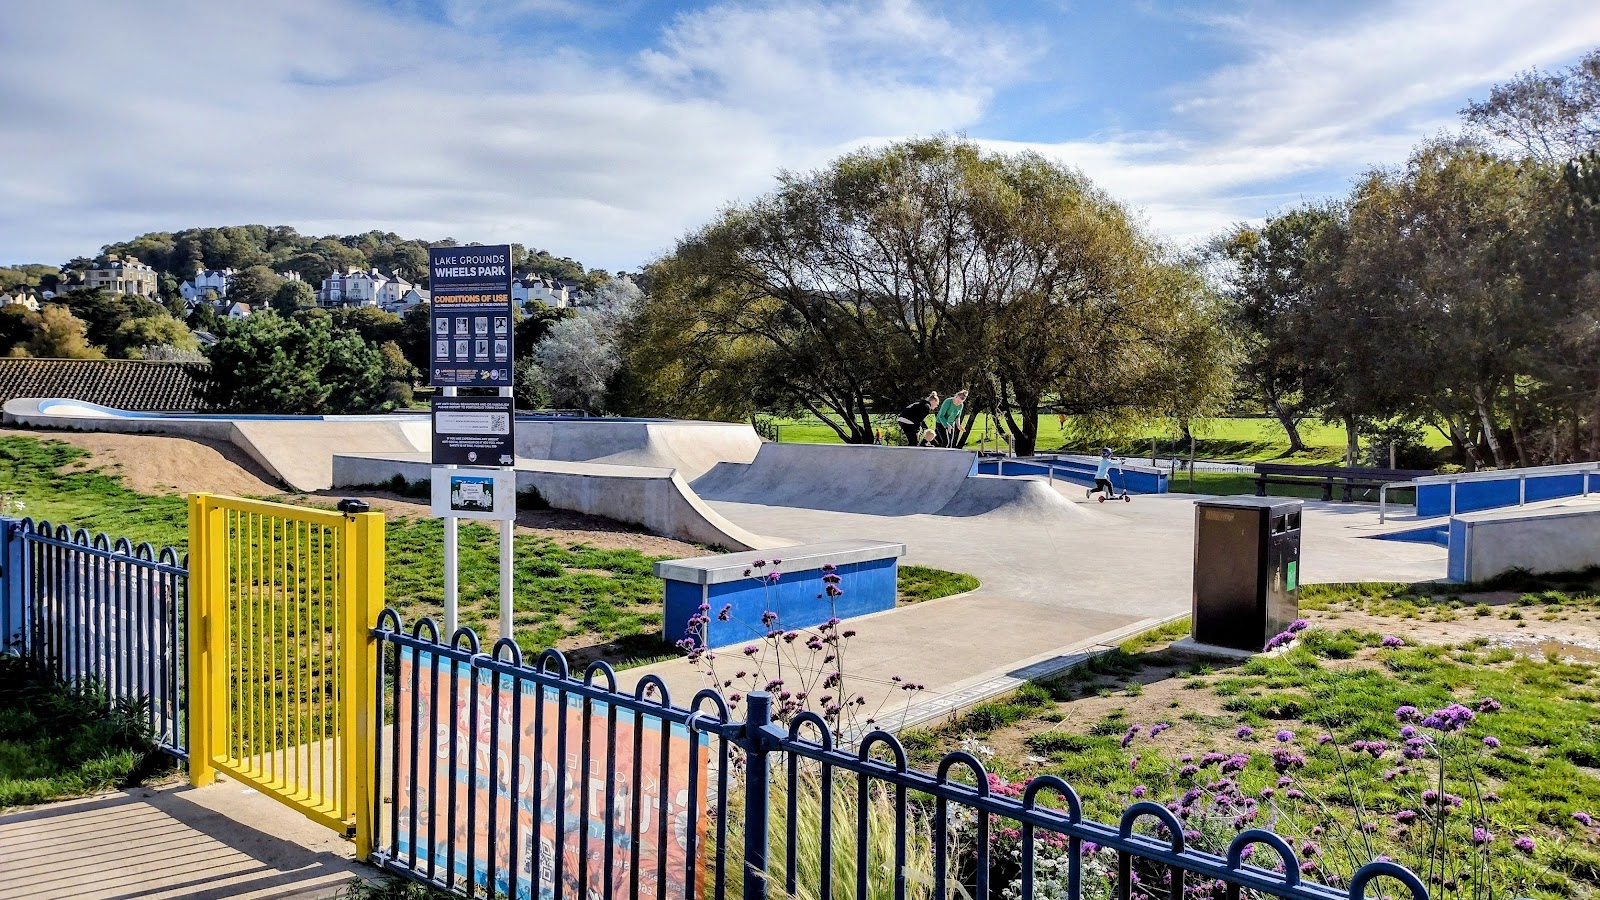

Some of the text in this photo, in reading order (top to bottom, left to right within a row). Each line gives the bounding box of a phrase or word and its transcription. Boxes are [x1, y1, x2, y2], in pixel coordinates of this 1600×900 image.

[434, 255, 505, 265] LAKE GROUNDS
[434, 266, 506, 277] WHEELS PARK
[434, 294, 509, 303] CONDITIONS OF USE
